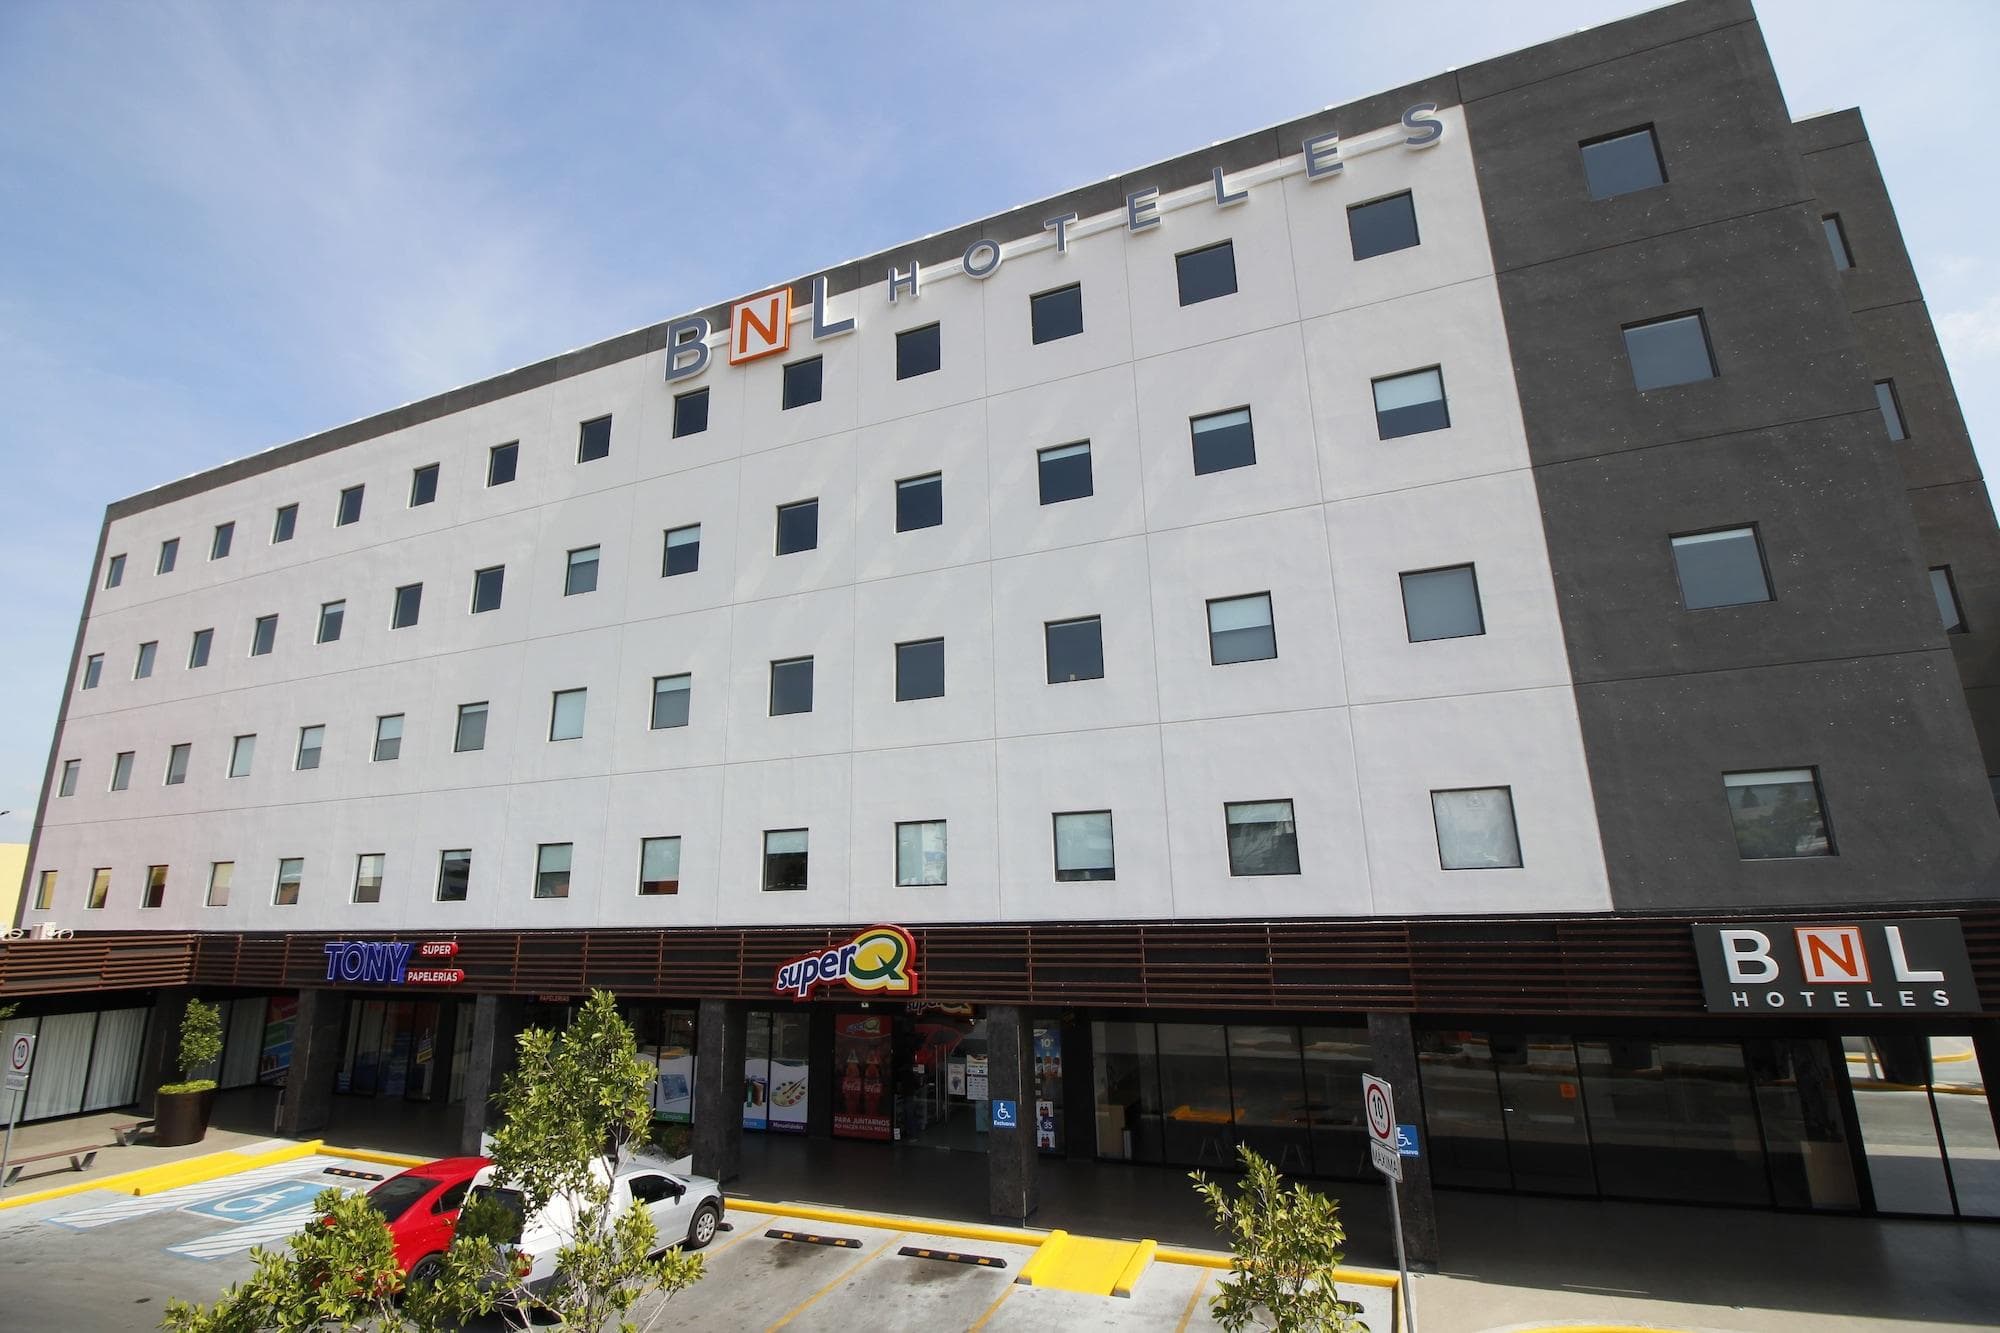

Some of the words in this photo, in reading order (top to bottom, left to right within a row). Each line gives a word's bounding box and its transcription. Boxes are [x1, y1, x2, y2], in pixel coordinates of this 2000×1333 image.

[664, 276, 857, 384] BNL
[887, 103, 1444, 304] HOTELES
[323, 942, 410, 982] TONY
[421, 945, 451, 955] SUPER
[1719, 926, 1945, 984] BNL
[407, 971, 459, 982] PAPELERIAS
[1731, 990, 1950, 1008] HOTELES
[1372, 1094, 1384, 1120] 10
